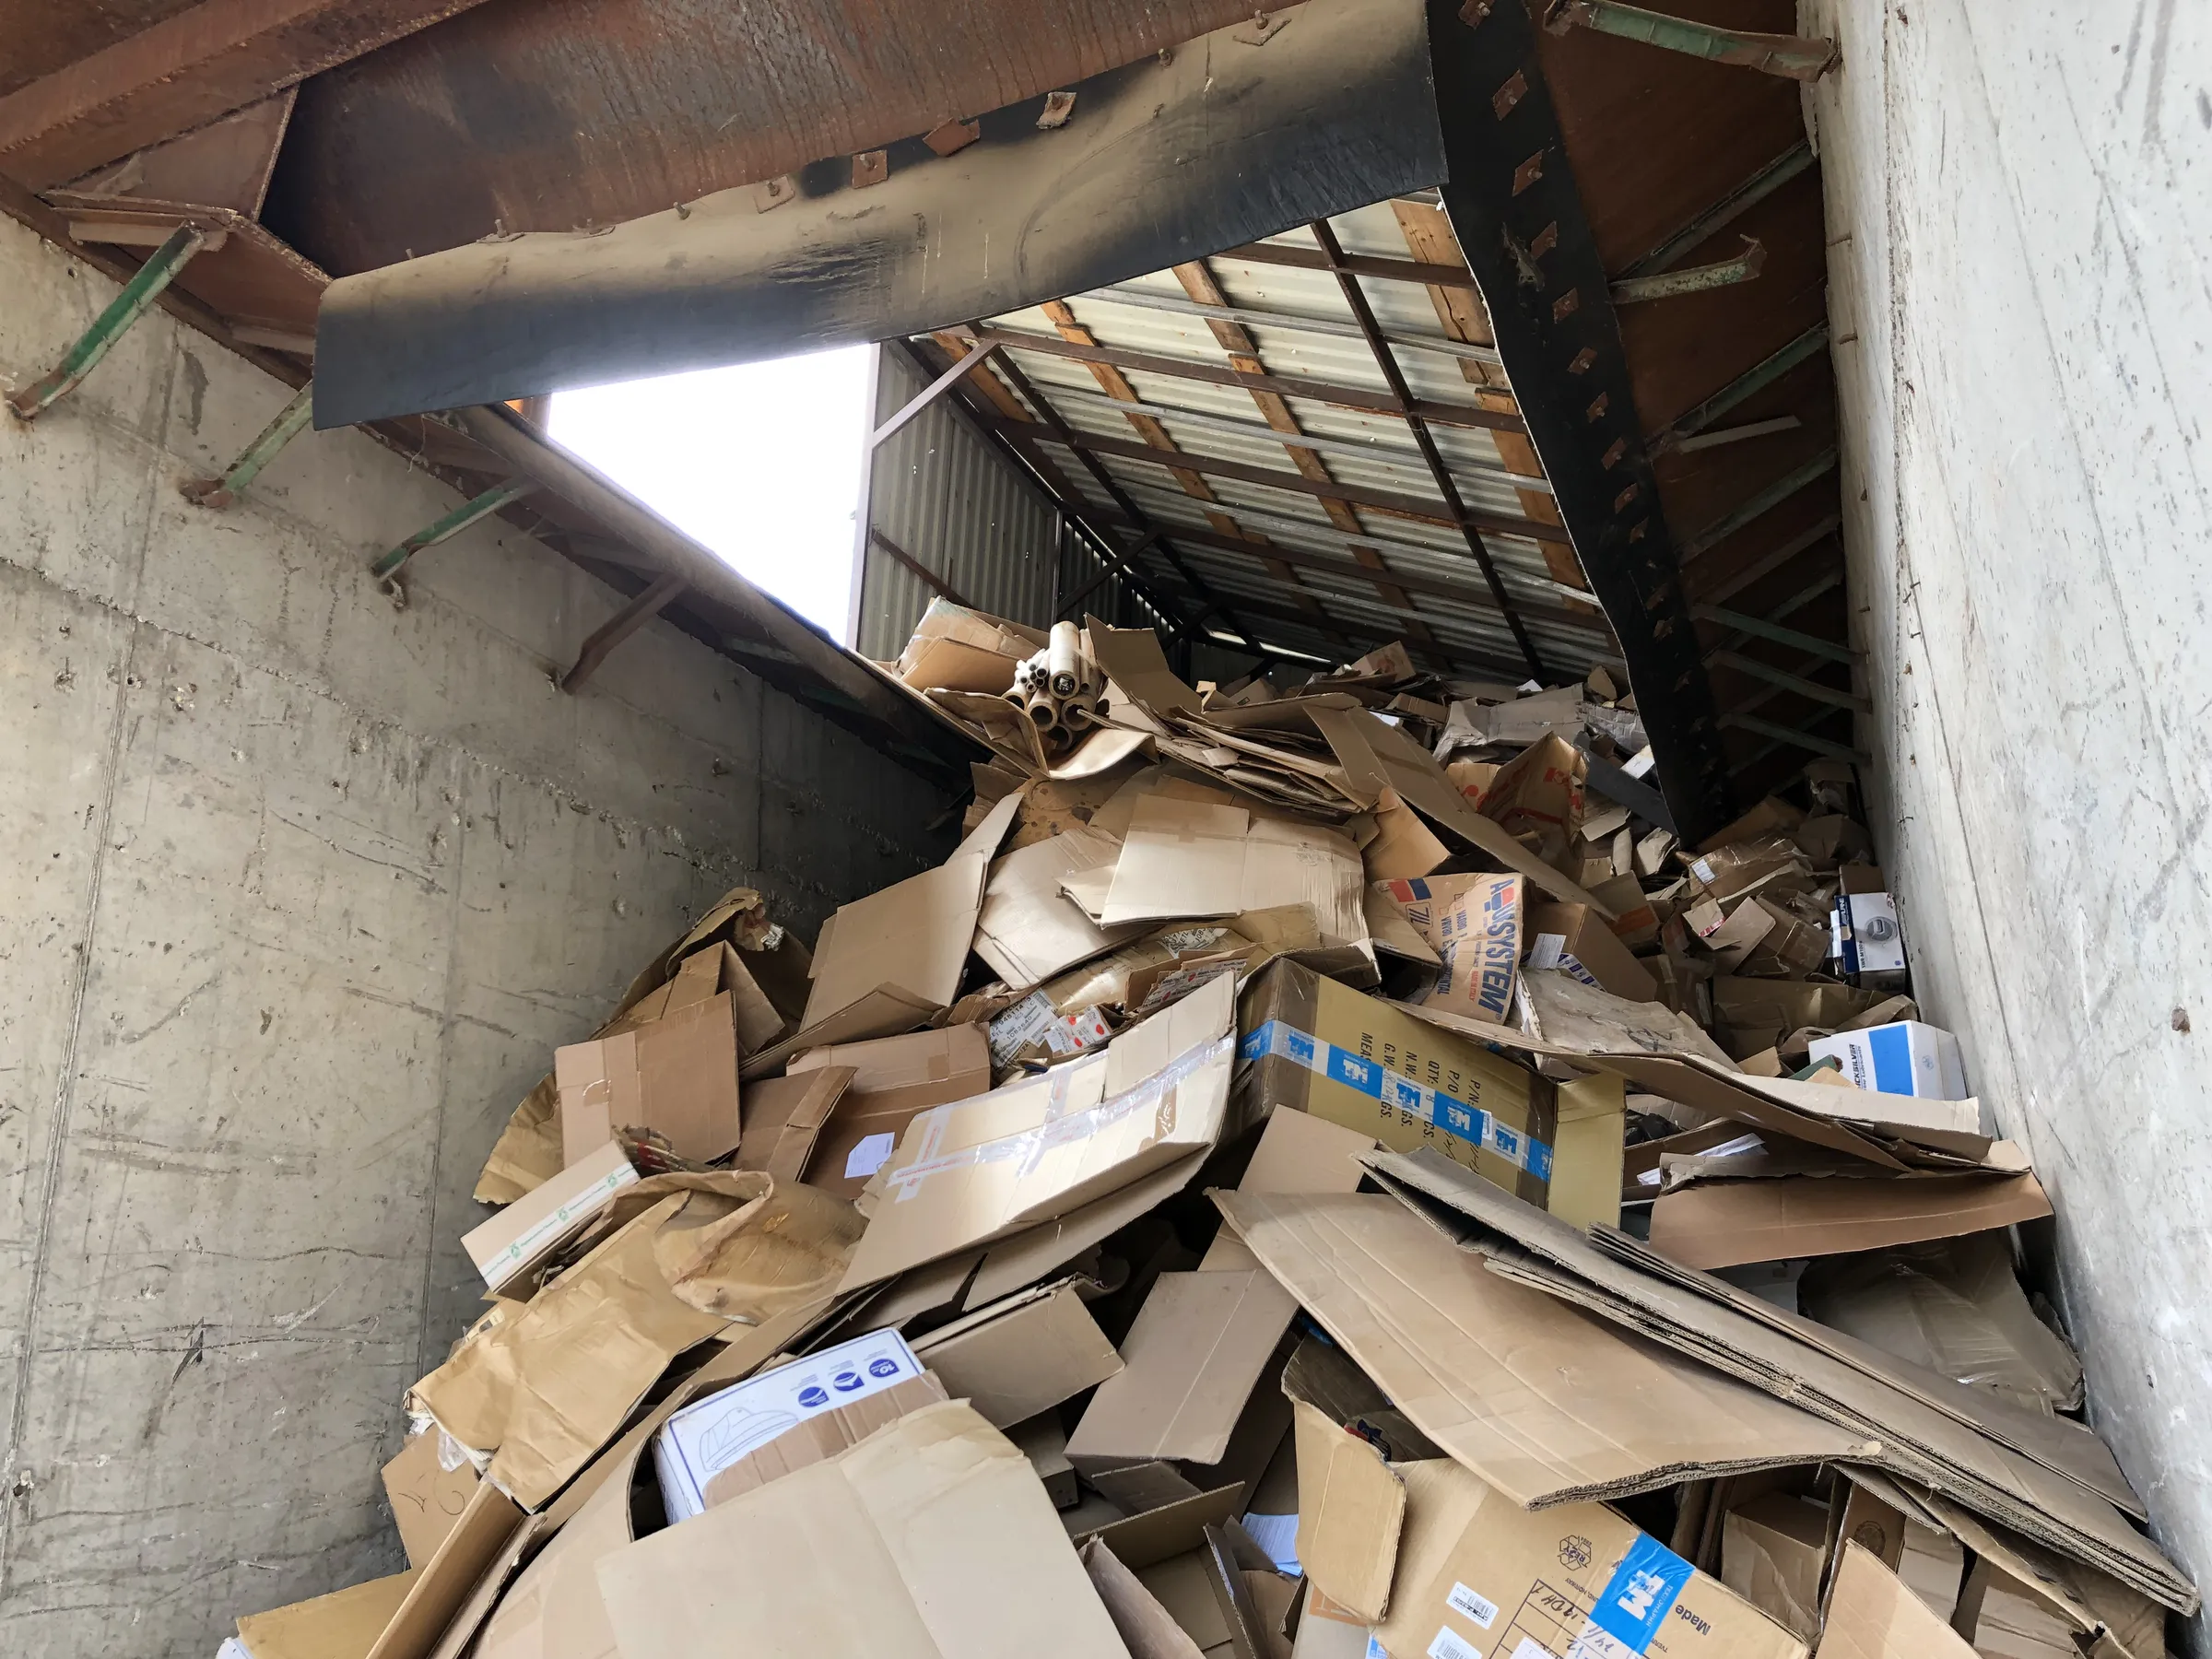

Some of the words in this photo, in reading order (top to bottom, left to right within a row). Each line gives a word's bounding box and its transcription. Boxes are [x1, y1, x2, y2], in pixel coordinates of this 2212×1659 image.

[1428, 1060, 1440, 1085] QTY:
[1849, 1043, 1862, 1089] ICKSILVER
[1675, 1604, 1712, 1636] Made
